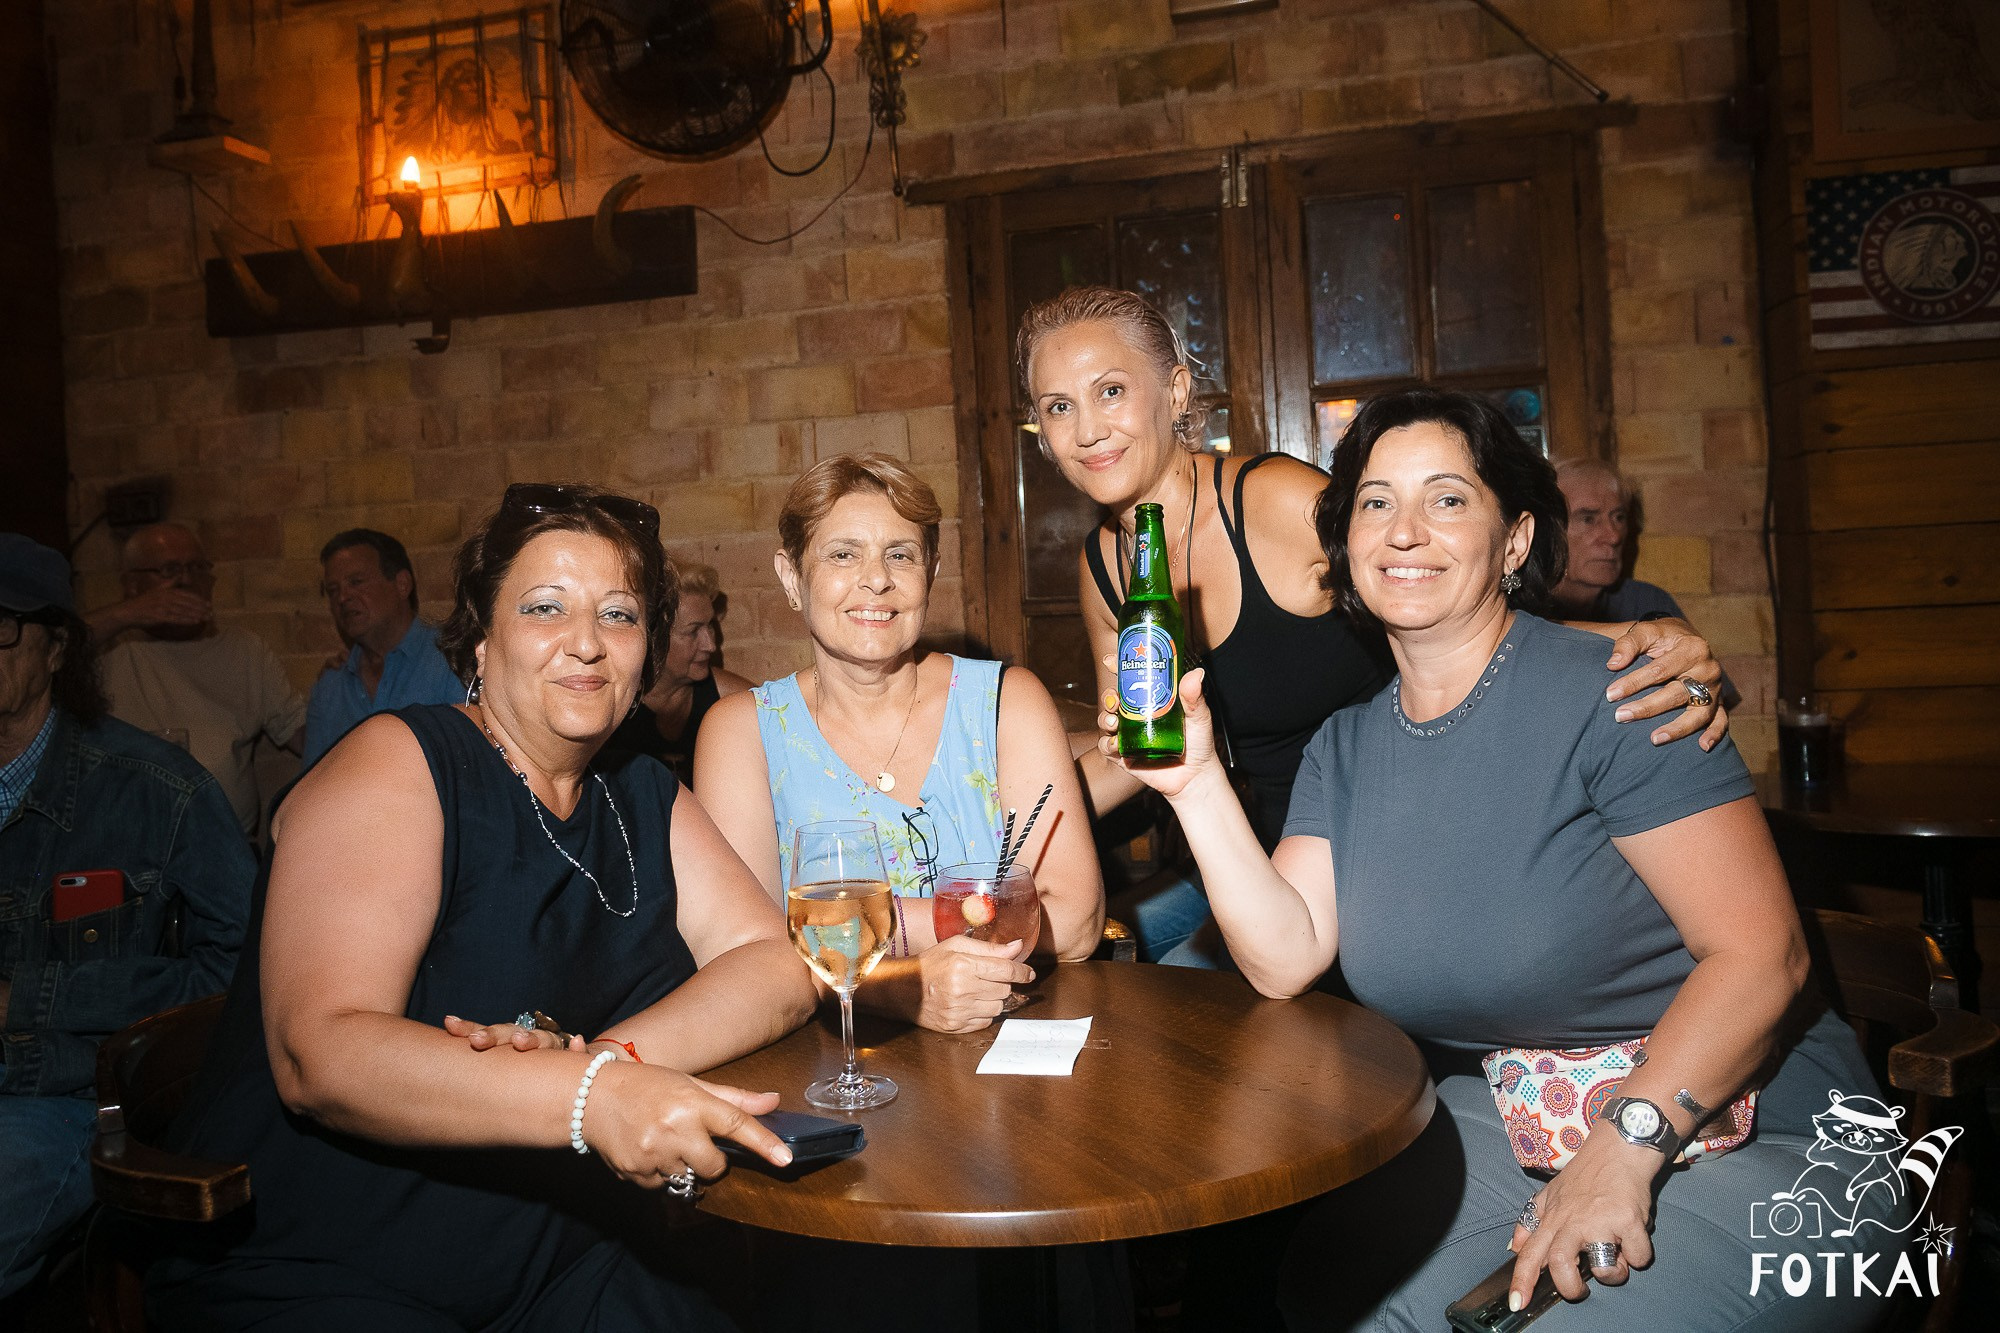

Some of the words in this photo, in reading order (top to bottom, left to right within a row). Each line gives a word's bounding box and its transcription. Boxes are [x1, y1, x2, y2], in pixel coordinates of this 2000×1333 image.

[1866, 215, 1895, 296] INDIAN
[1900, 196, 1998, 289] MOTORCYCLE
[1908, 299, 1959, 316] 1901
